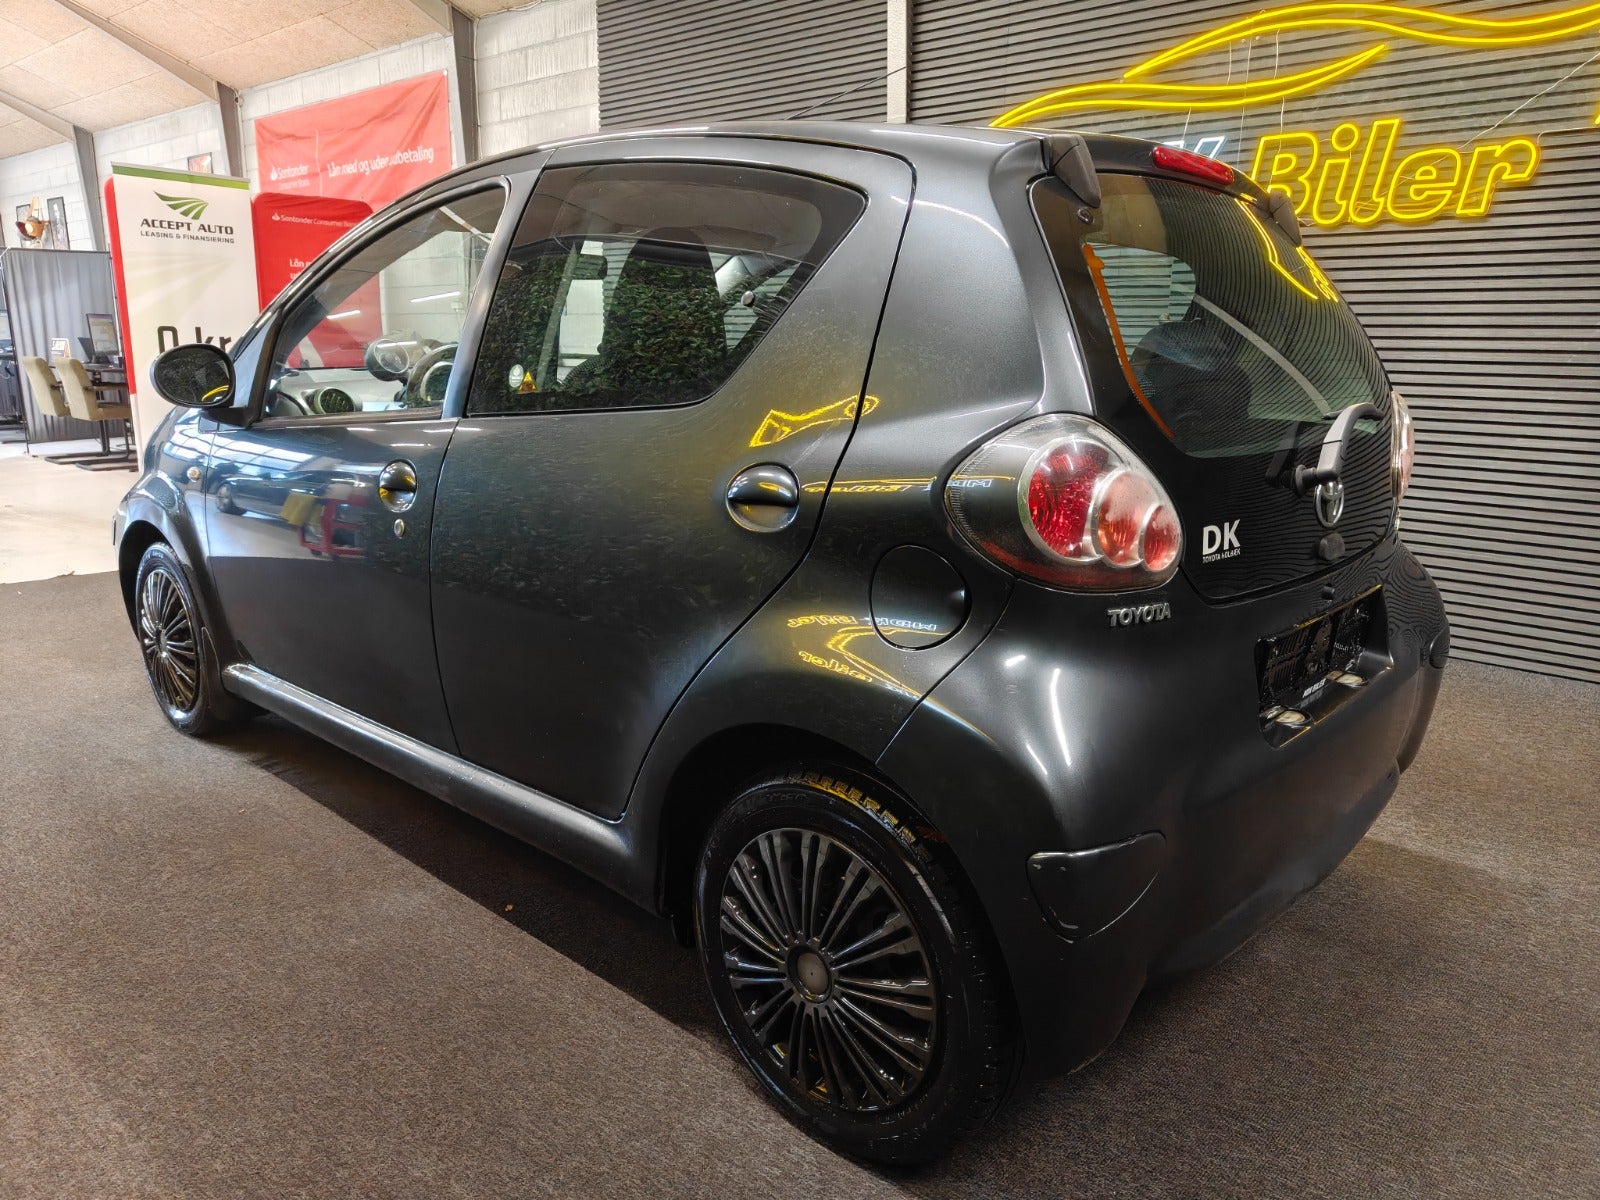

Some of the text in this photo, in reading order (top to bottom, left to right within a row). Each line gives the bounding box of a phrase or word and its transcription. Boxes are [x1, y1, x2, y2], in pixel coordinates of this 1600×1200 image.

[277, 164, 308, 179] Santander
[359, 160, 370, 176] og
[1250, 118, 1538, 226] Biler
[140, 218, 234, 235] ACCEPT AUTO
[280, 214, 312, 224] Santander
[140, 230, 174, 239] LEASING
[182, 233, 235, 244] FINANSIERING
[289, 258, 305, 268] Lån
[1202, 518, 1241, 556] DK
[1202, 553, 1221, 564] TOYOTA
[1107, 602, 1172, 627] TOYOTA
